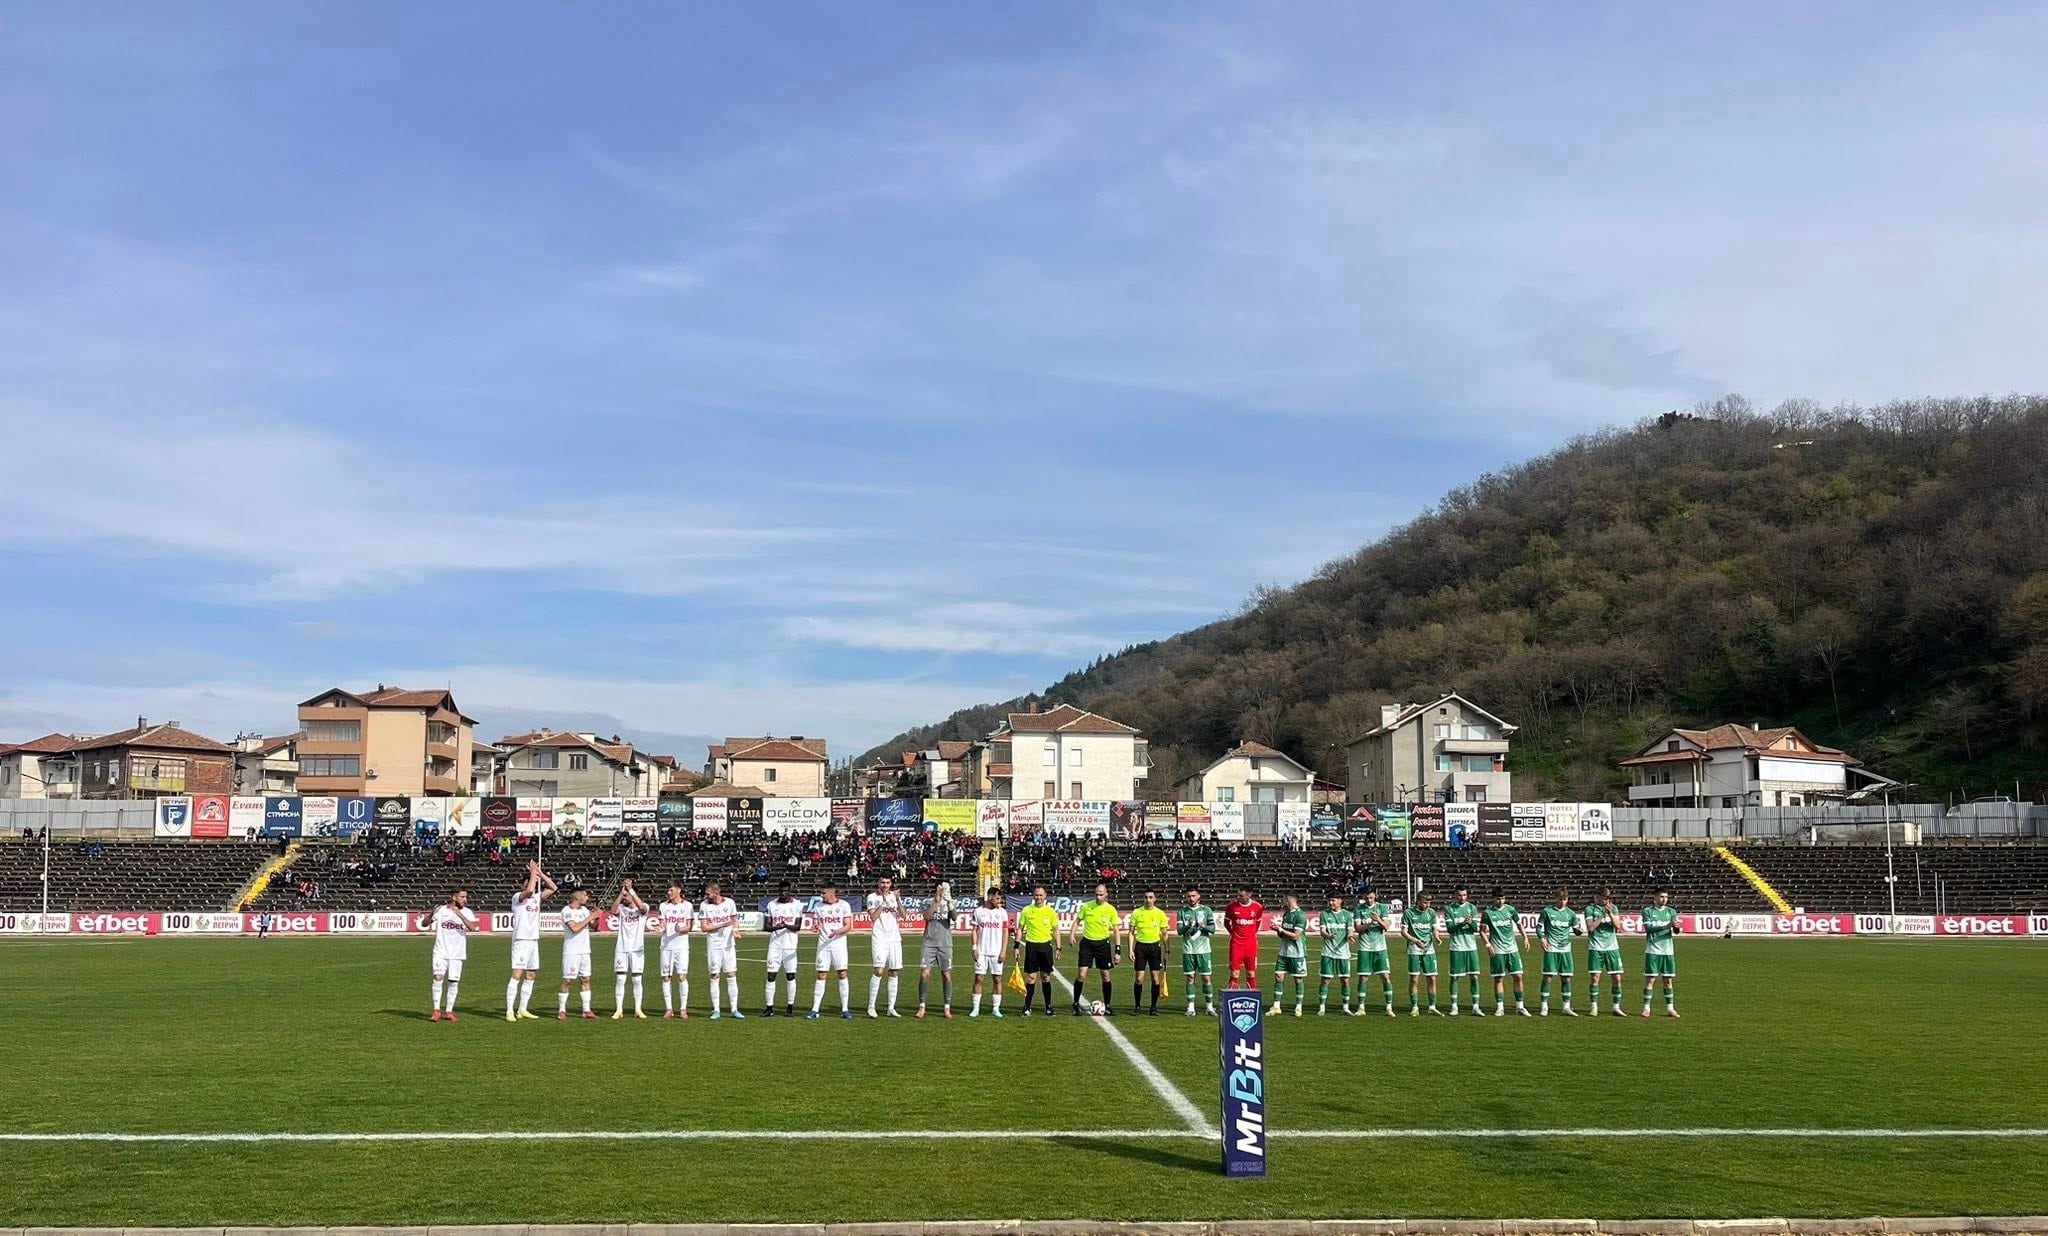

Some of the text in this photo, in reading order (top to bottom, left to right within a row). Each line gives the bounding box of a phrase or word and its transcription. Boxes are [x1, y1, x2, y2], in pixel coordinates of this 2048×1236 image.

[232, 801, 264, 809] Evans
[1513, 806, 1543, 815] DIES
[766, 810, 828, 818] OGICOM
[1546, 814, 1577, 824] CITY
[1513, 818, 1543, 827] DIES
[1514, 830, 1544, 839] DIES
[78, 914, 149, 932] efbet
[166, 915, 190, 929] 100
[333, 915, 356, 929] 100
[1700, 917, 1721, 930] 100
[1776, 916, 1841, 932] efbet
[1859, 917, 1883, 930] 100
[1904, 923, 1931, 931] ПЕТРИЧ
[1942, 917, 2013, 933] efbet
[1229, 1038, 1263, 1156] MrBit
